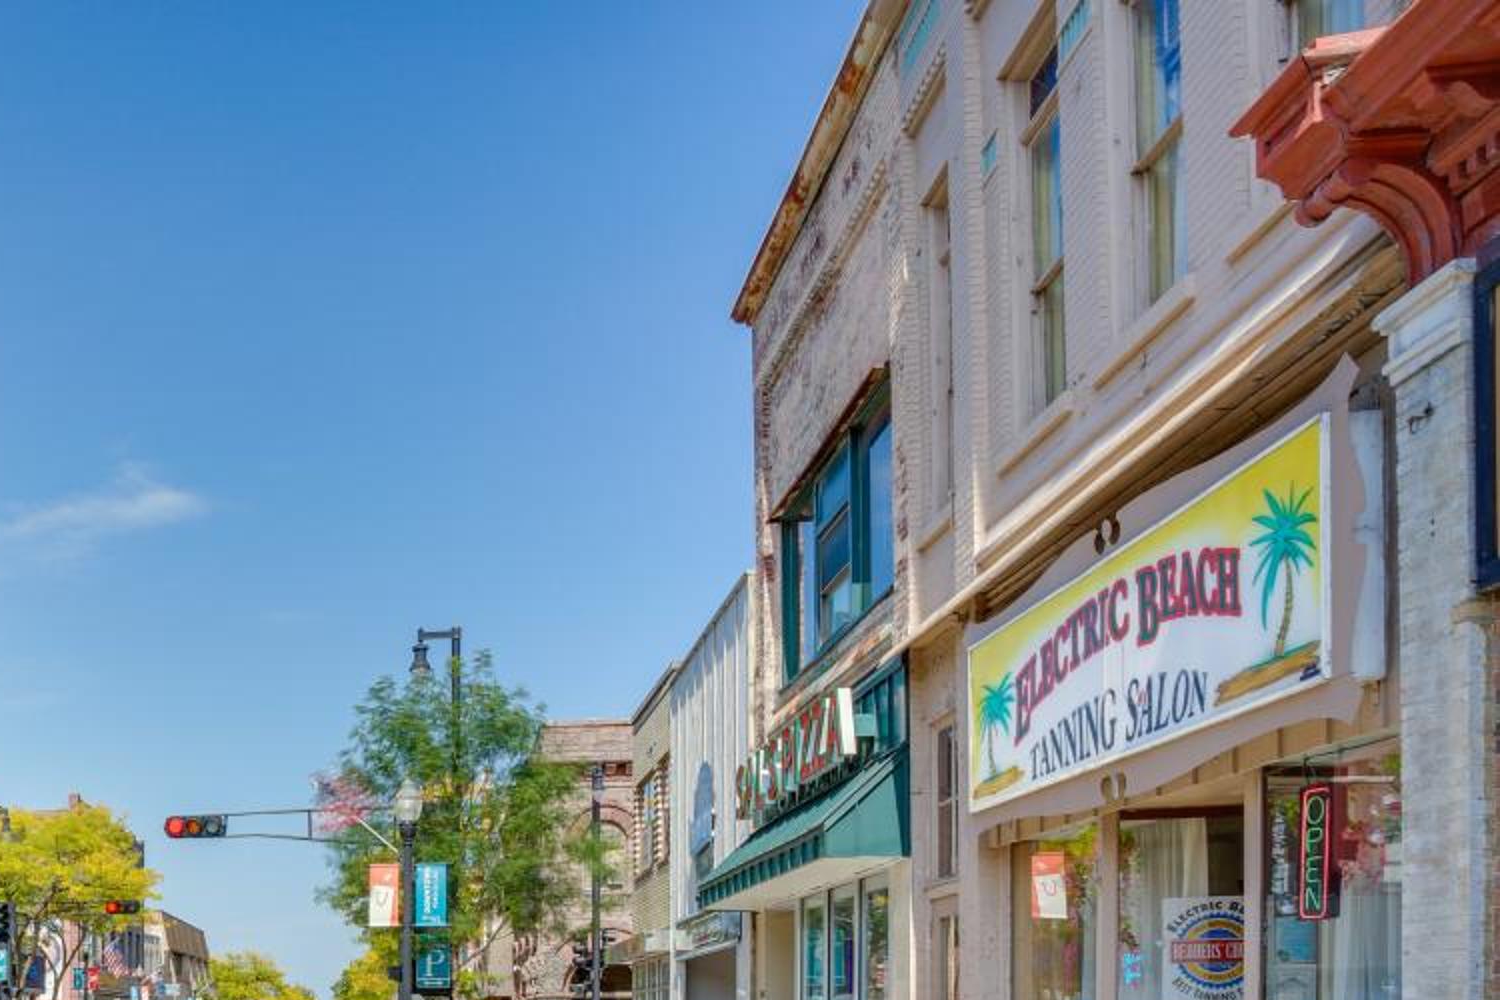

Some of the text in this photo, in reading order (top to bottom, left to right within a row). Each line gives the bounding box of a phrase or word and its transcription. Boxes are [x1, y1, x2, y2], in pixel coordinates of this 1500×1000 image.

[1013, 547, 1243, 748] ELECTRIC BEACH
[1030, 668, 1209, 781] TANNING SALON
[1305, 795, 1325, 911] OPEN
[426, 948, 446, 978] P
[1166, 900, 1223, 933] ELECTRIC
